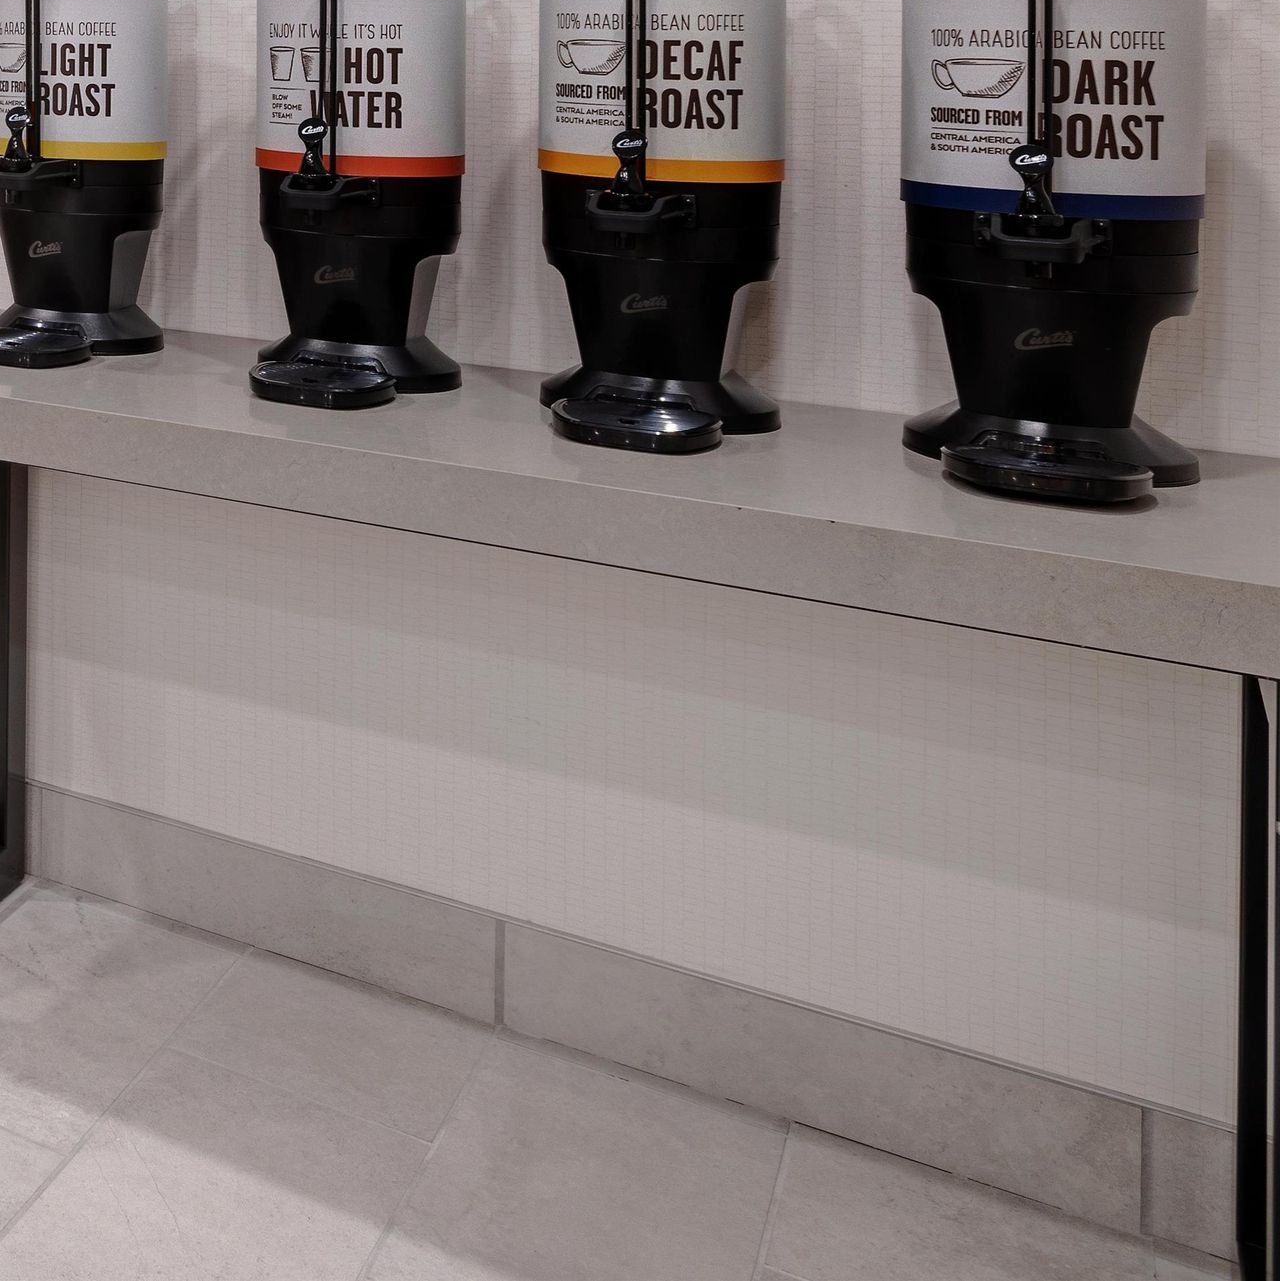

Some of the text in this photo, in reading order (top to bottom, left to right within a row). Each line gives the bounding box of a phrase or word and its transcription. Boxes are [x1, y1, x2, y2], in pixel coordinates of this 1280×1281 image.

[45, 22, 74, 36] BEAN
[78, 22, 117, 36] COFFEE
[270, 23, 294, 38] ENJOY
[298, 23, 307, 38] IT
[354, 23, 375, 39] IT'S
[380, 24, 403, 39] HOT
[556, 13, 580, 29] 100%
[651, 14, 689, 31] BEAN
[697, 15, 744, 31] COFFEE
[931, 29, 964, 47] 100%
[1054, 30, 1102, 49] BEAN
[1110, 31, 1166, 50] COFFEE
[344, 47, 403, 84] HOT
[637, 40, 744, 81] DECAF
[1042, 59, 1156, 105] DARK
[40, 83, 115, 117] ROAST
[556, 83, 626, 101] SOURCED FROM
[272, 111, 293, 119] STEAM!
[556, 106, 624, 116] CENTRAL AMERICA
[637, 88, 743, 130] ROAST
[930, 107, 1023, 127] SOURCED FROM
[560, 117, 584, 125] SOUTH
[585, 118, 625, 127] AMERICA
[930, 133, 1021, 145] CENTRAL AMERICA
[1038, 113, 1164, 160] ROAST
[930, 143, 1013, 155] & SOUTH AMERIC
